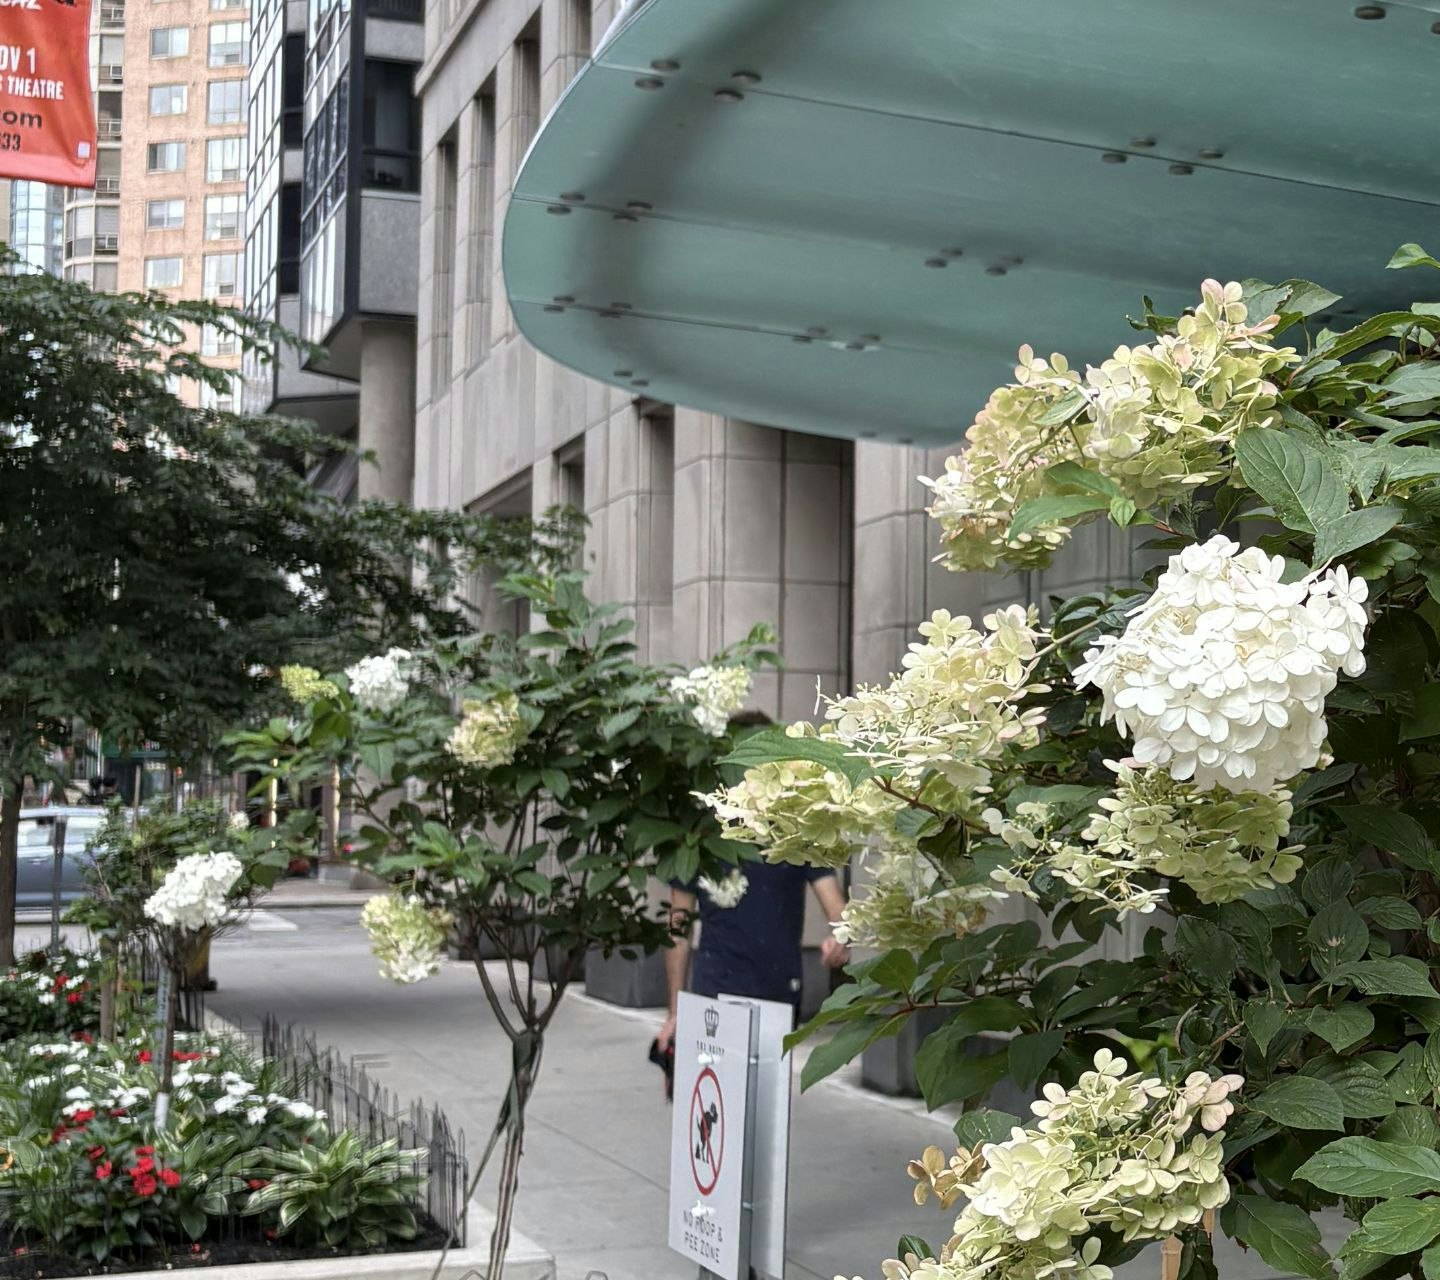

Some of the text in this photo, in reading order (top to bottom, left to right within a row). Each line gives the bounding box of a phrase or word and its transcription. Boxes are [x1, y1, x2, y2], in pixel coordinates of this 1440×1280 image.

[27, 47, 36, 75] 1
[8, 75, 64, 100] THEATRE
[0, 110, 42, 129] om
[0, 132, 21, 152] 33
